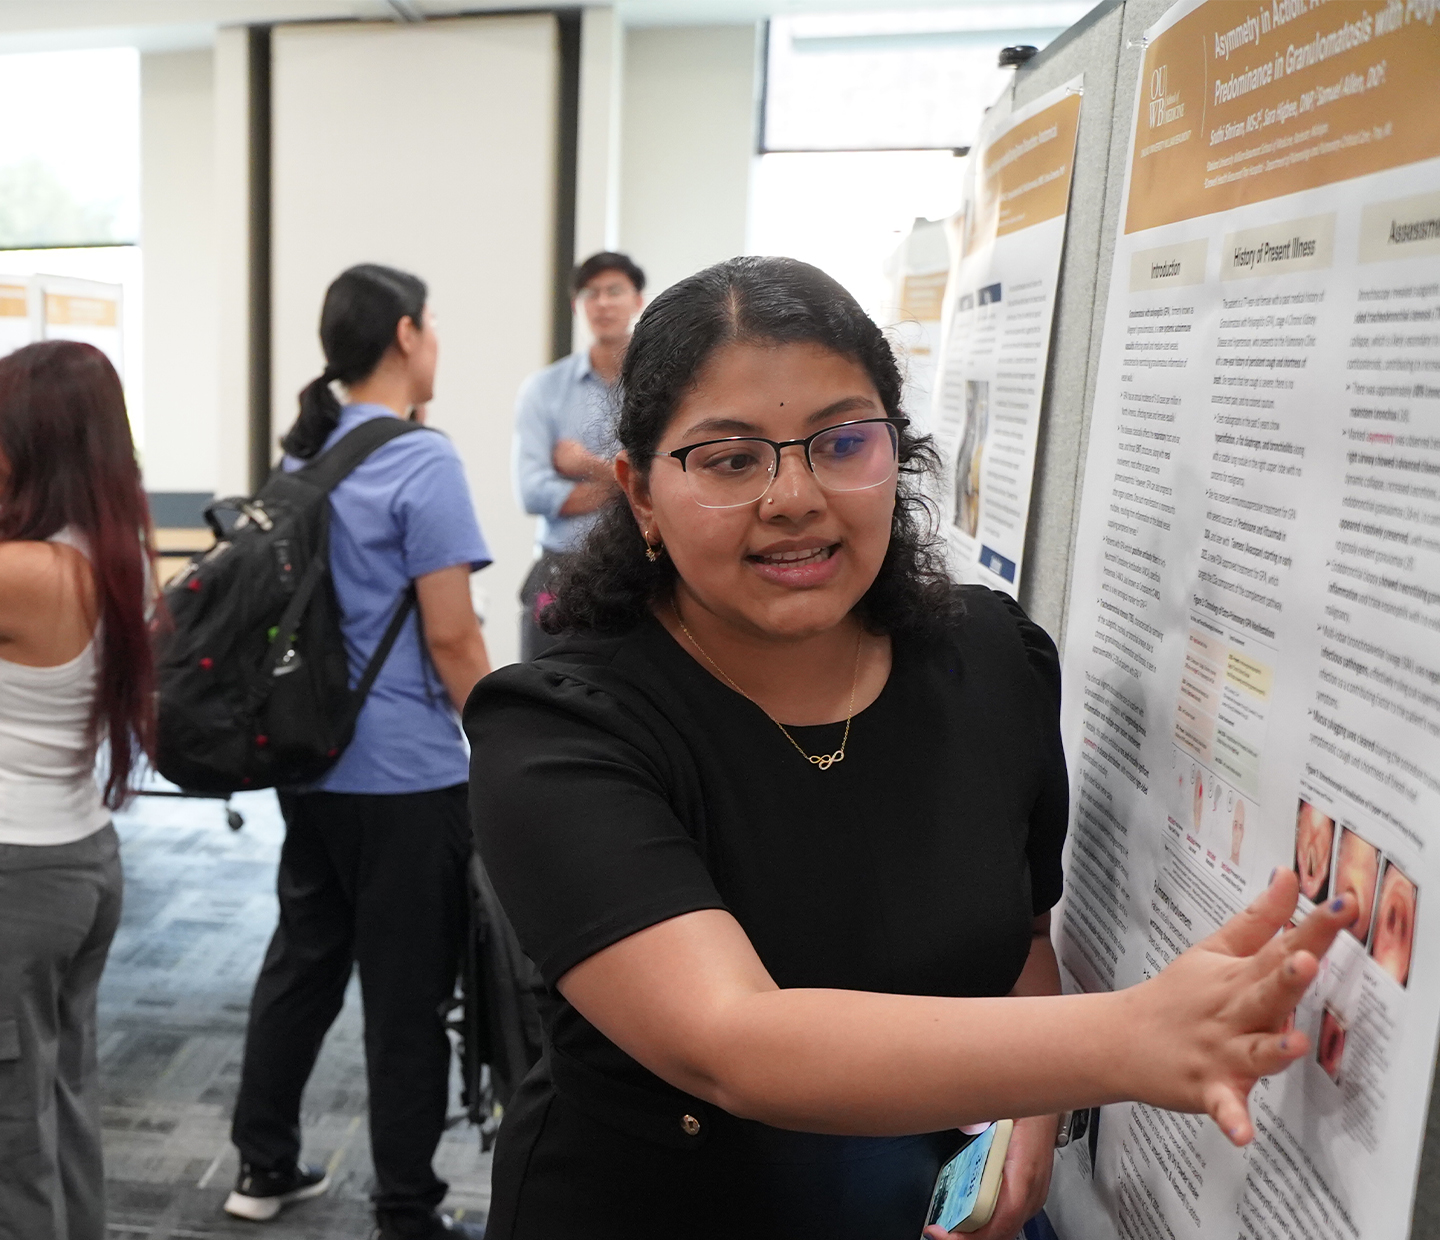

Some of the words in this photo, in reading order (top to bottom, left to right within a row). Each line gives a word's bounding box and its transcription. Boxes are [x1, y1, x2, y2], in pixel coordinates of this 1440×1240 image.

[1215, 16, 1260, 60] Asymmetry
[1260, 5, 1271, 34] in
[1214, 62, 1273, 105] Predominance
[1274, 51, 1284, 80] in
[1286, 10, 1373, 75] Granulomatosis
[1151, 258, 1181, 279] Introduction
[1234, 243, 1256, 270] History
[1257, 243, 1264, 261] of
[1264, 240, 1291, 263] Present
[1292, 237, 1317, 260] Illness
